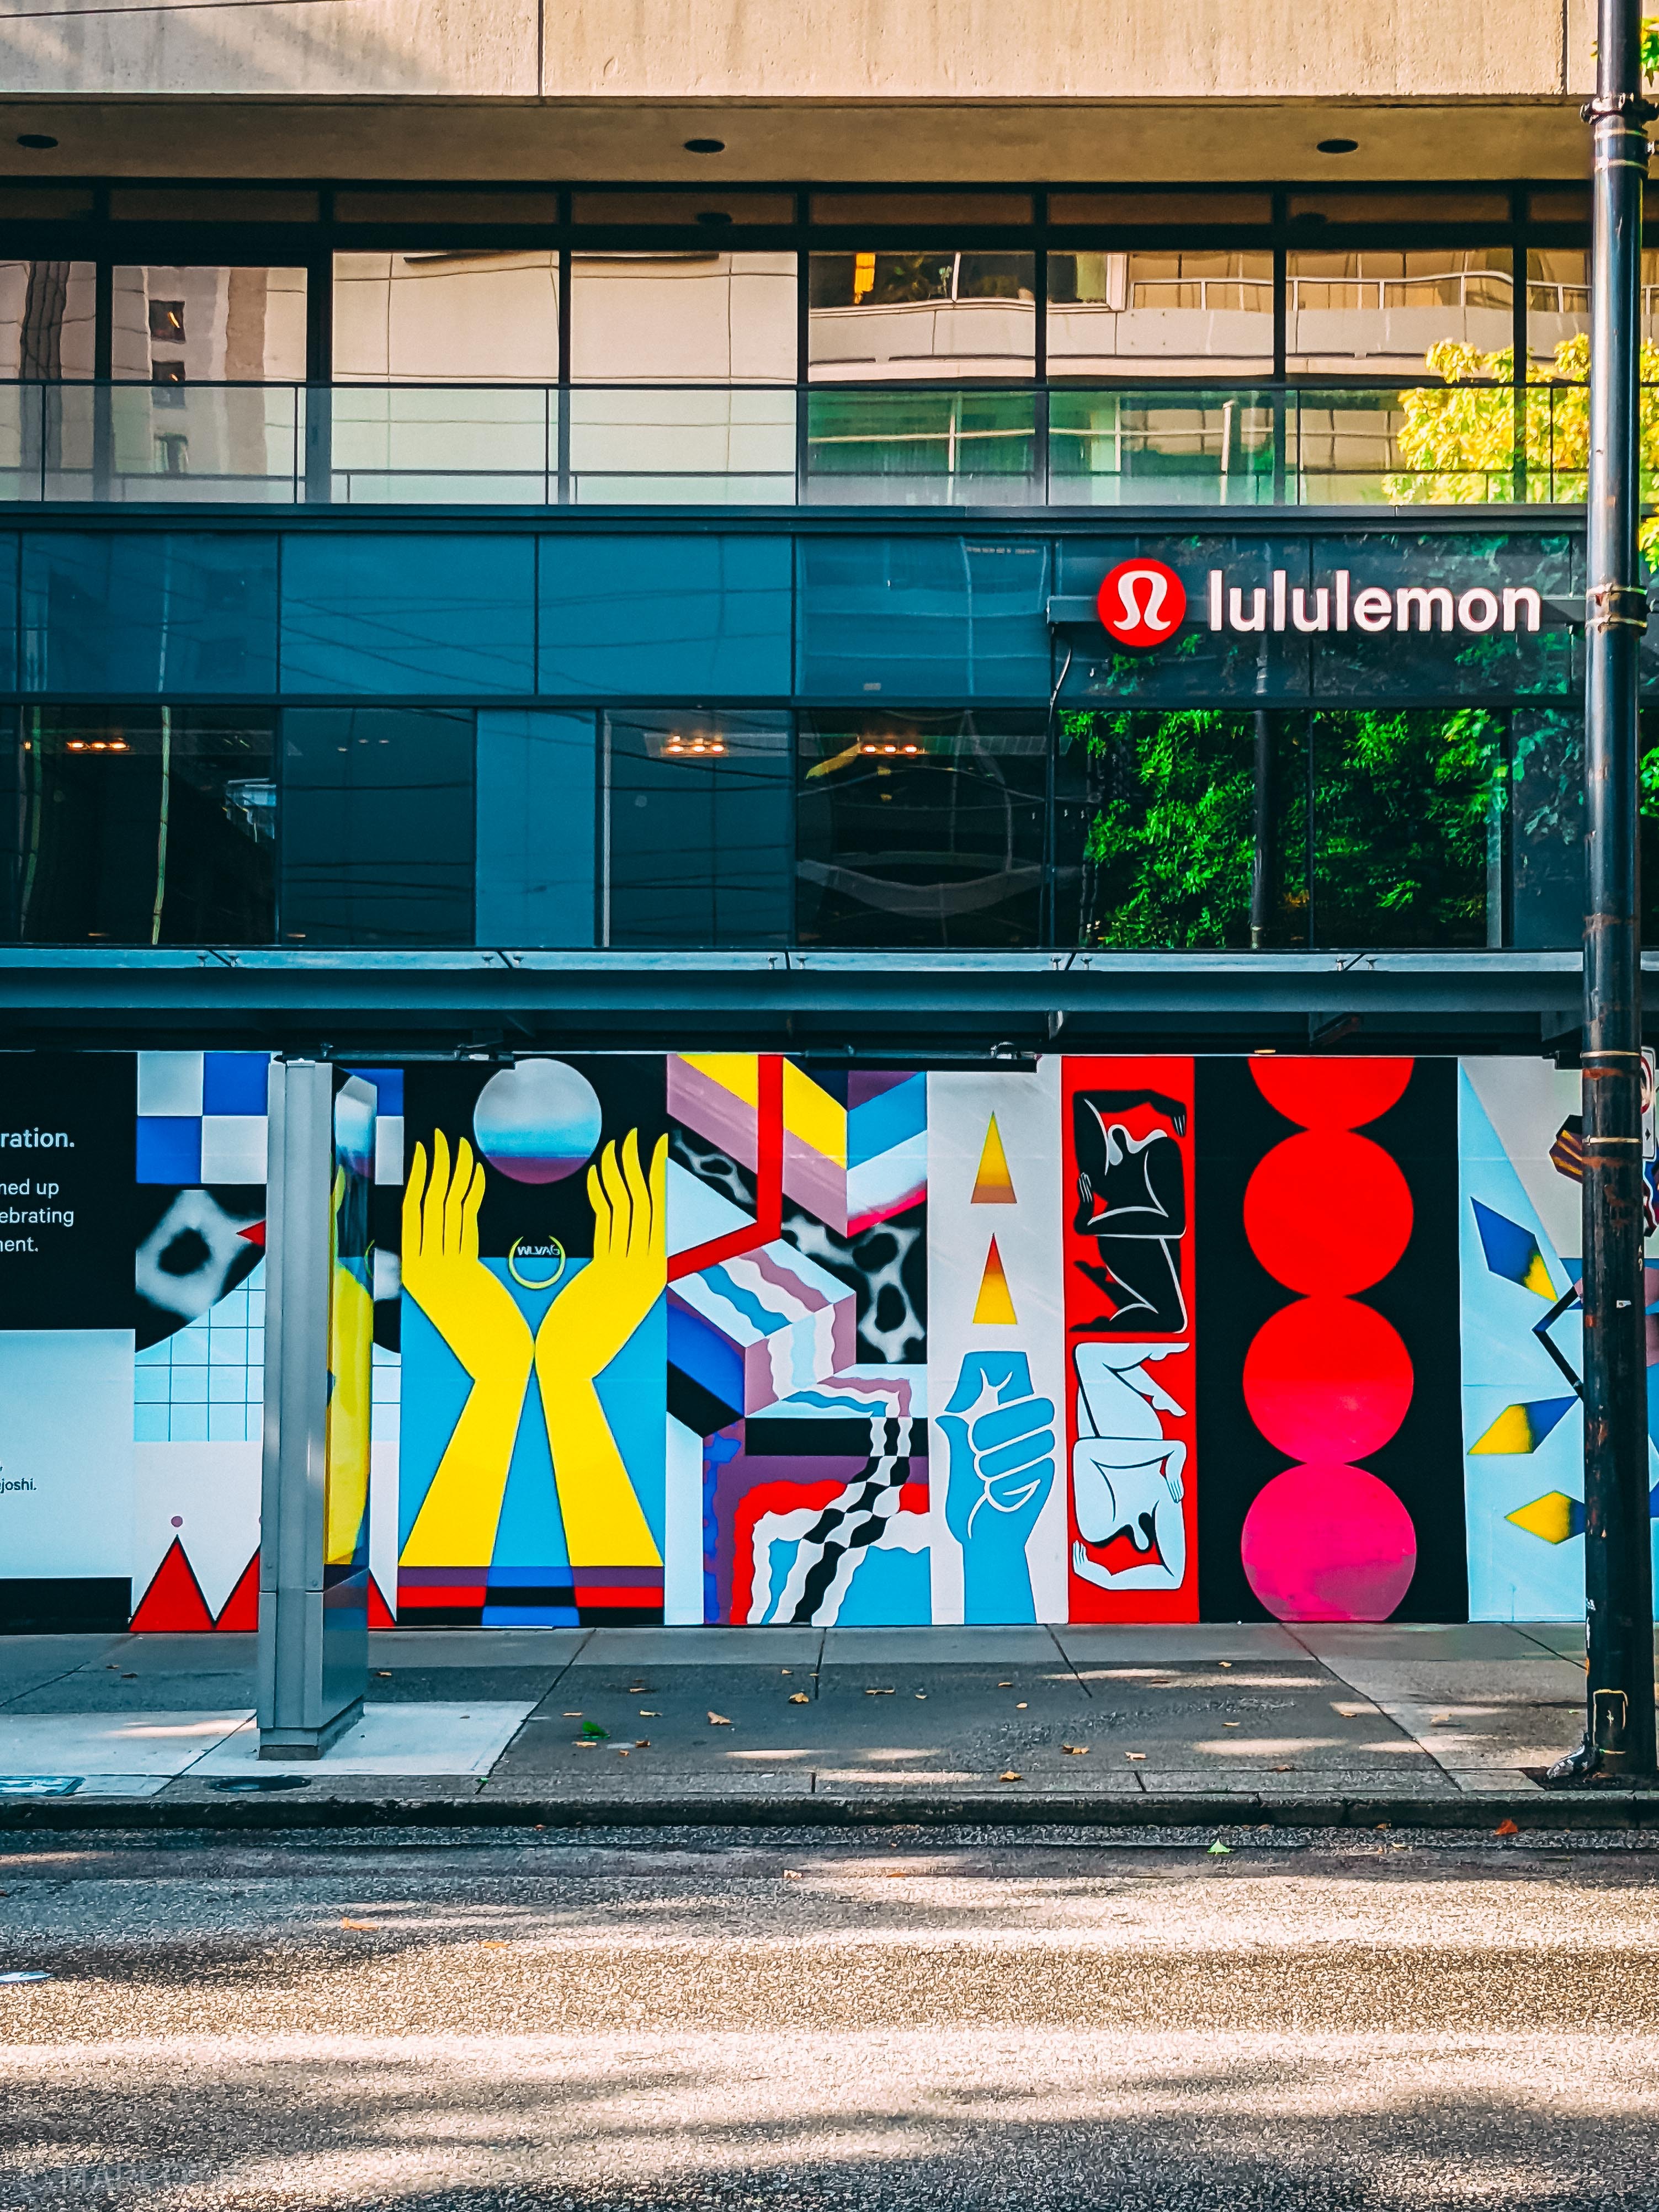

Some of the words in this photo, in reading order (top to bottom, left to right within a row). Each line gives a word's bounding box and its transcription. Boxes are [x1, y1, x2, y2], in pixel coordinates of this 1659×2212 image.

[1208, 569, 1541, 632] lululemon
[1, 1126, 75, 1148] ration.
[36, 1183, 59, 1199] up
[0, 1237, 39, 1252] ent.
[0, 1477, 37, 1494] joshi.
